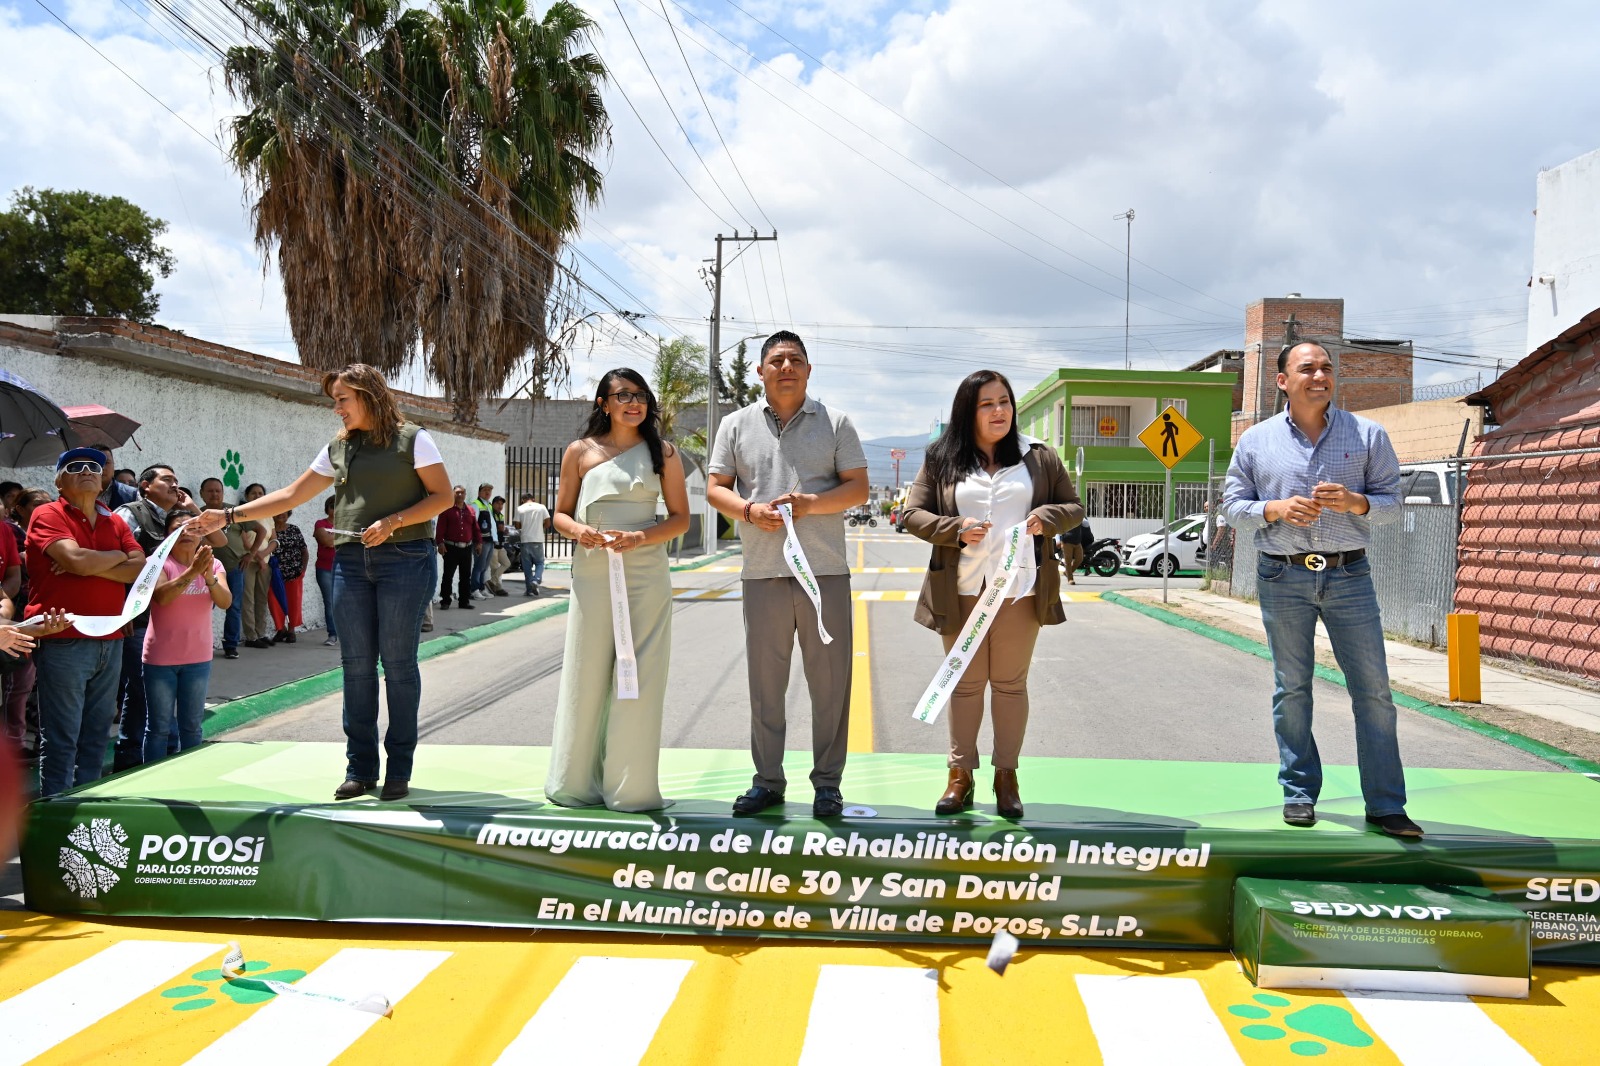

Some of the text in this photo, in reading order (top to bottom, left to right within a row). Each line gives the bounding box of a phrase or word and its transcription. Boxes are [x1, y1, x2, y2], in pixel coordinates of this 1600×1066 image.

[477, 823, 1210, 871] Inauguración de la Rehabilitación Integral
[137, 864, 259, 875] PARA LOS POTOSINOS
[173, 877, 188, 885] DEL
[613, 864, 1061, 902] de la Calle 30 y San David
[1526, 877, 1600, 903] SED
[537, 898, 1143, 939] En el Municipio de Villa de Pozos, S.L.P.
[1290, 901, 1452, 920] SEDUVOP
[1527, 911, 1597, 923] SECRETARÍA
[1293, 922, 1484, 939] SECRETARÍA DE DESARROLLO URBANO,
[1293, 930, 1340, 940] VIVIENDA
[1351, 934, 1385, 942] OBRAS
[1387, 934, 1436, 944] PÚBLICAS
[1536, 931, 1576, 940] OBRAS
